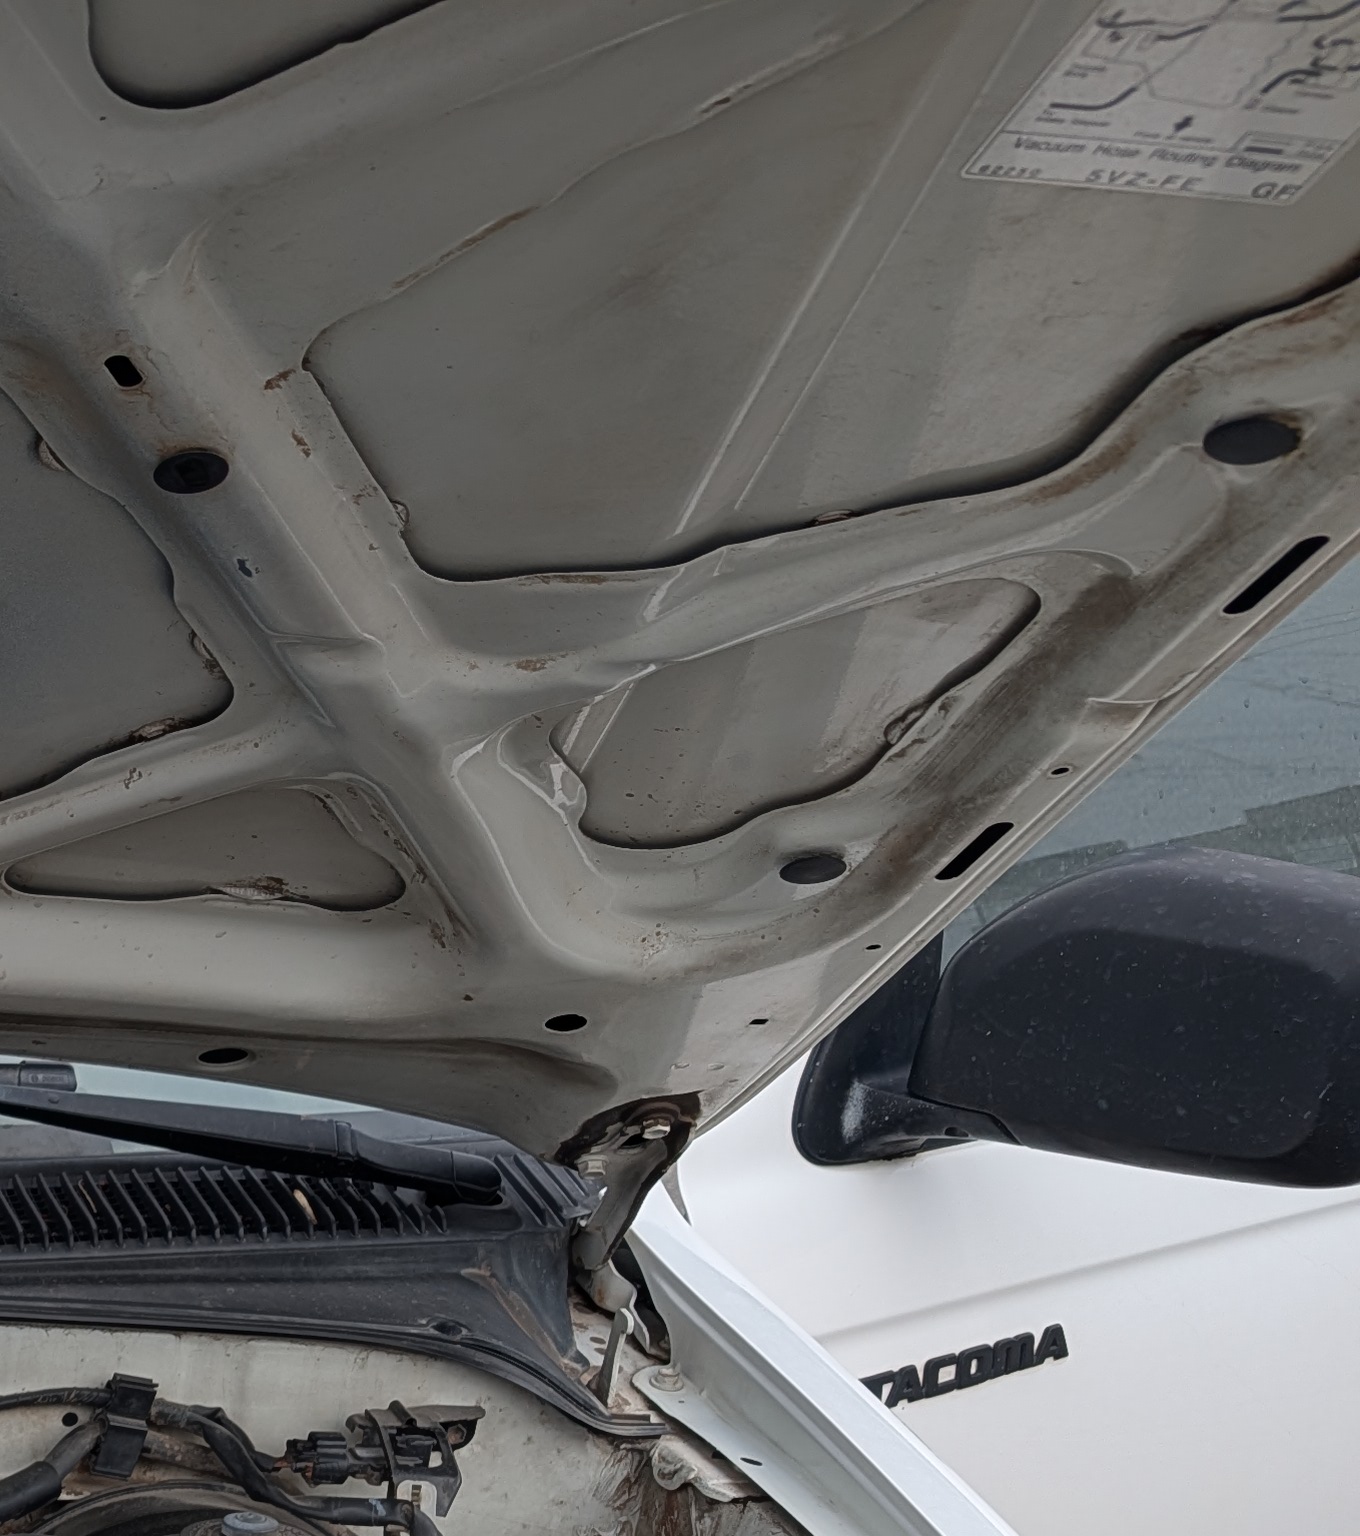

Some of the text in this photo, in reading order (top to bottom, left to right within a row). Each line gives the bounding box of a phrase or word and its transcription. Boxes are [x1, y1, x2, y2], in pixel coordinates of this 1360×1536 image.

[1013, 137, 1303, 173] Vacuum Hose Routing Diagram
[1084, 169, 1204, 190] 5VZ-FE
[858, 1323, 1069, 1409] TACOMA
